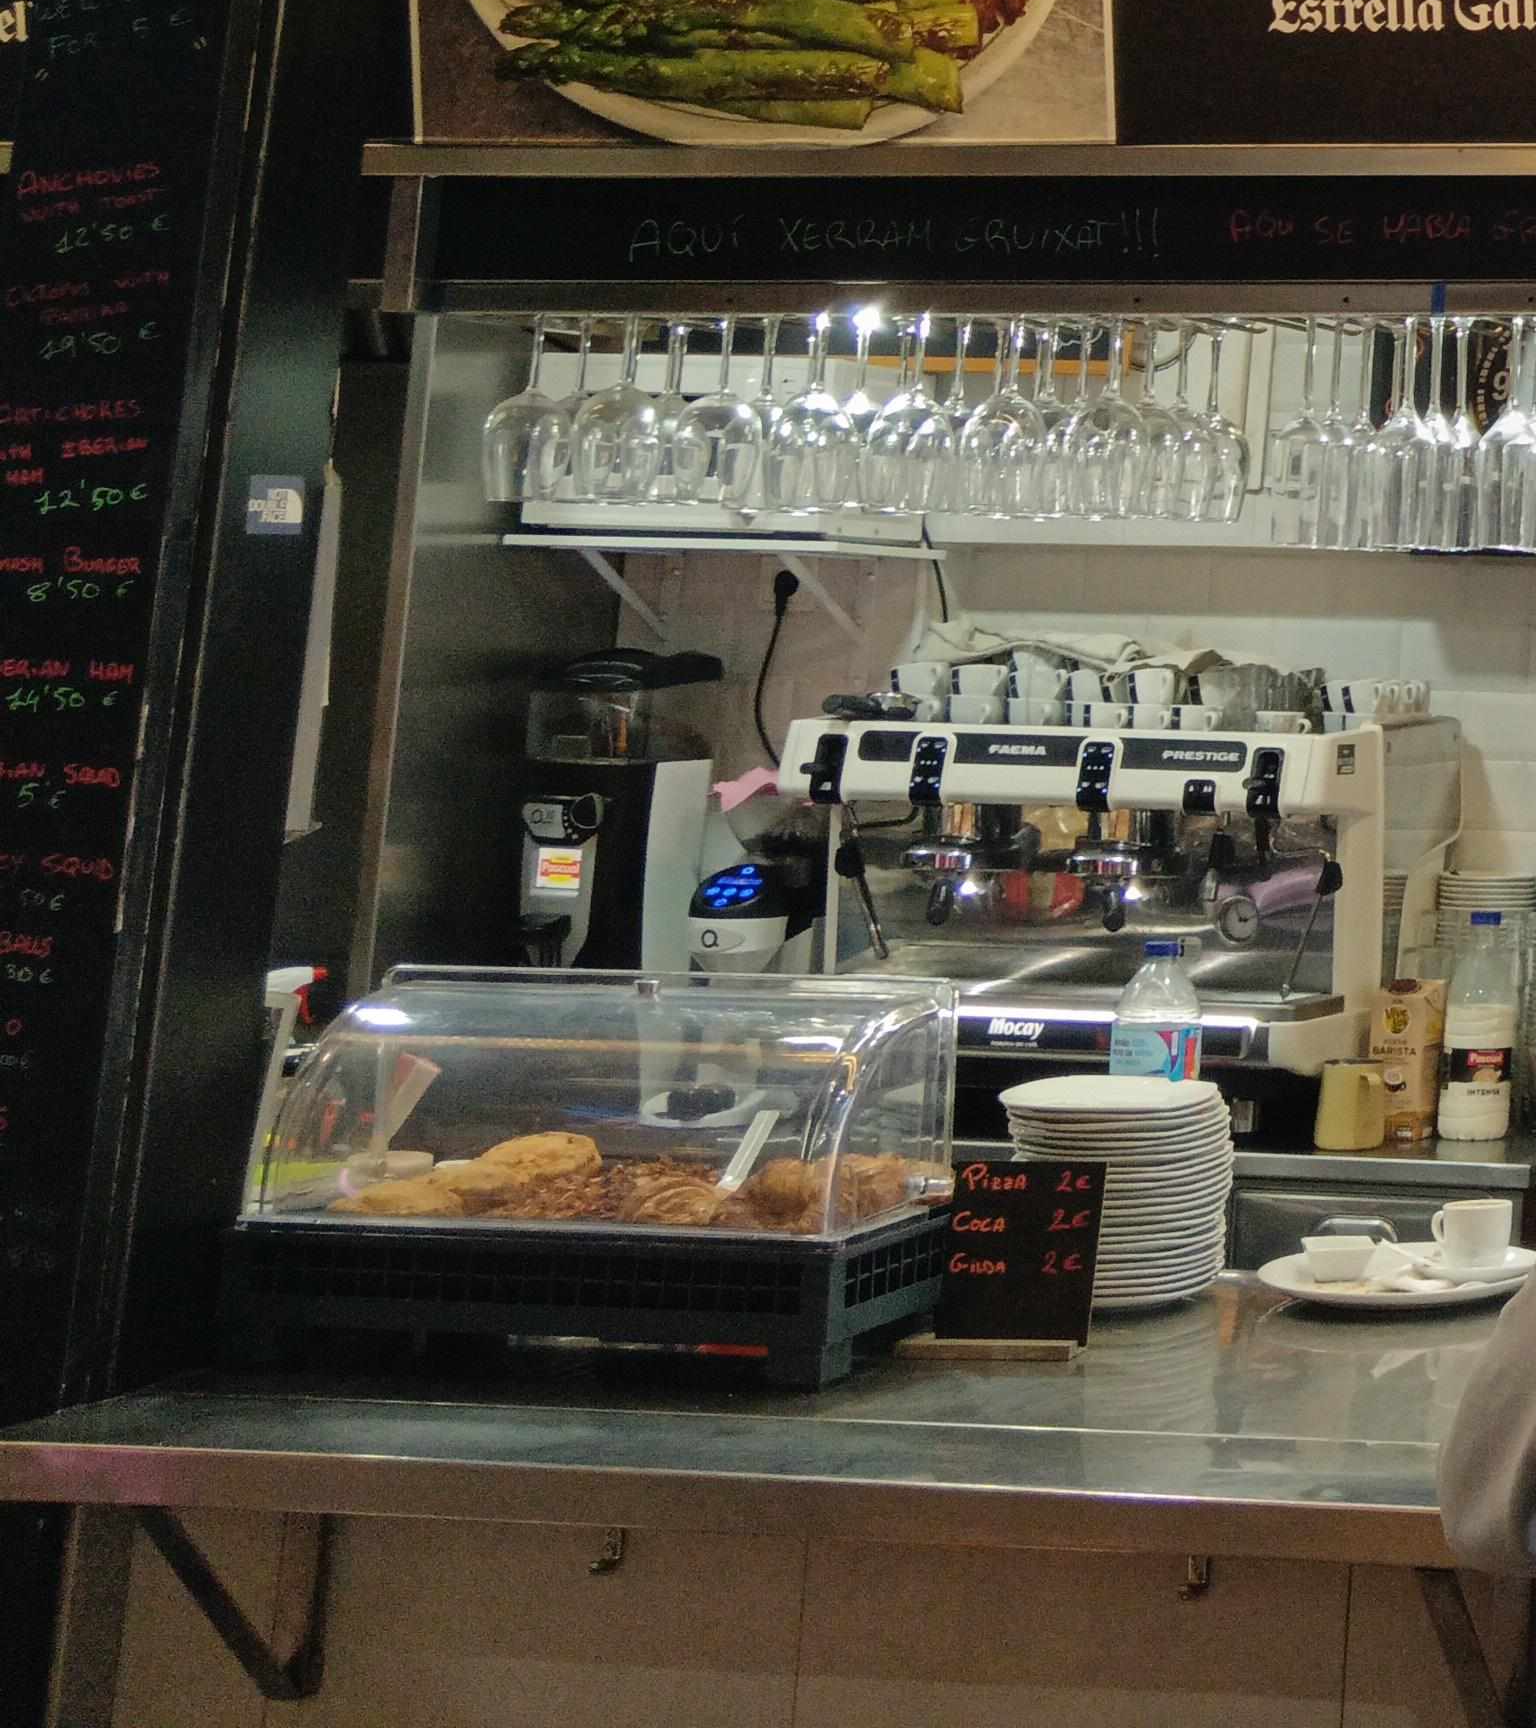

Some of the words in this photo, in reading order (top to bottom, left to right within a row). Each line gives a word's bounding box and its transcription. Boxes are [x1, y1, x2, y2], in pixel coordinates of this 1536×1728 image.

[987, 743, 1048, 757] FAEMA
[1161, 748, 1241, 763] PRESTIGE
[987, 1016, 1046, 1041] Mocay
[961, 1161, 1028, 1192] PIZZA
[951, 1210, 1008, 1233] COCA
[948, 1251, 1008, 1275] GILDA
